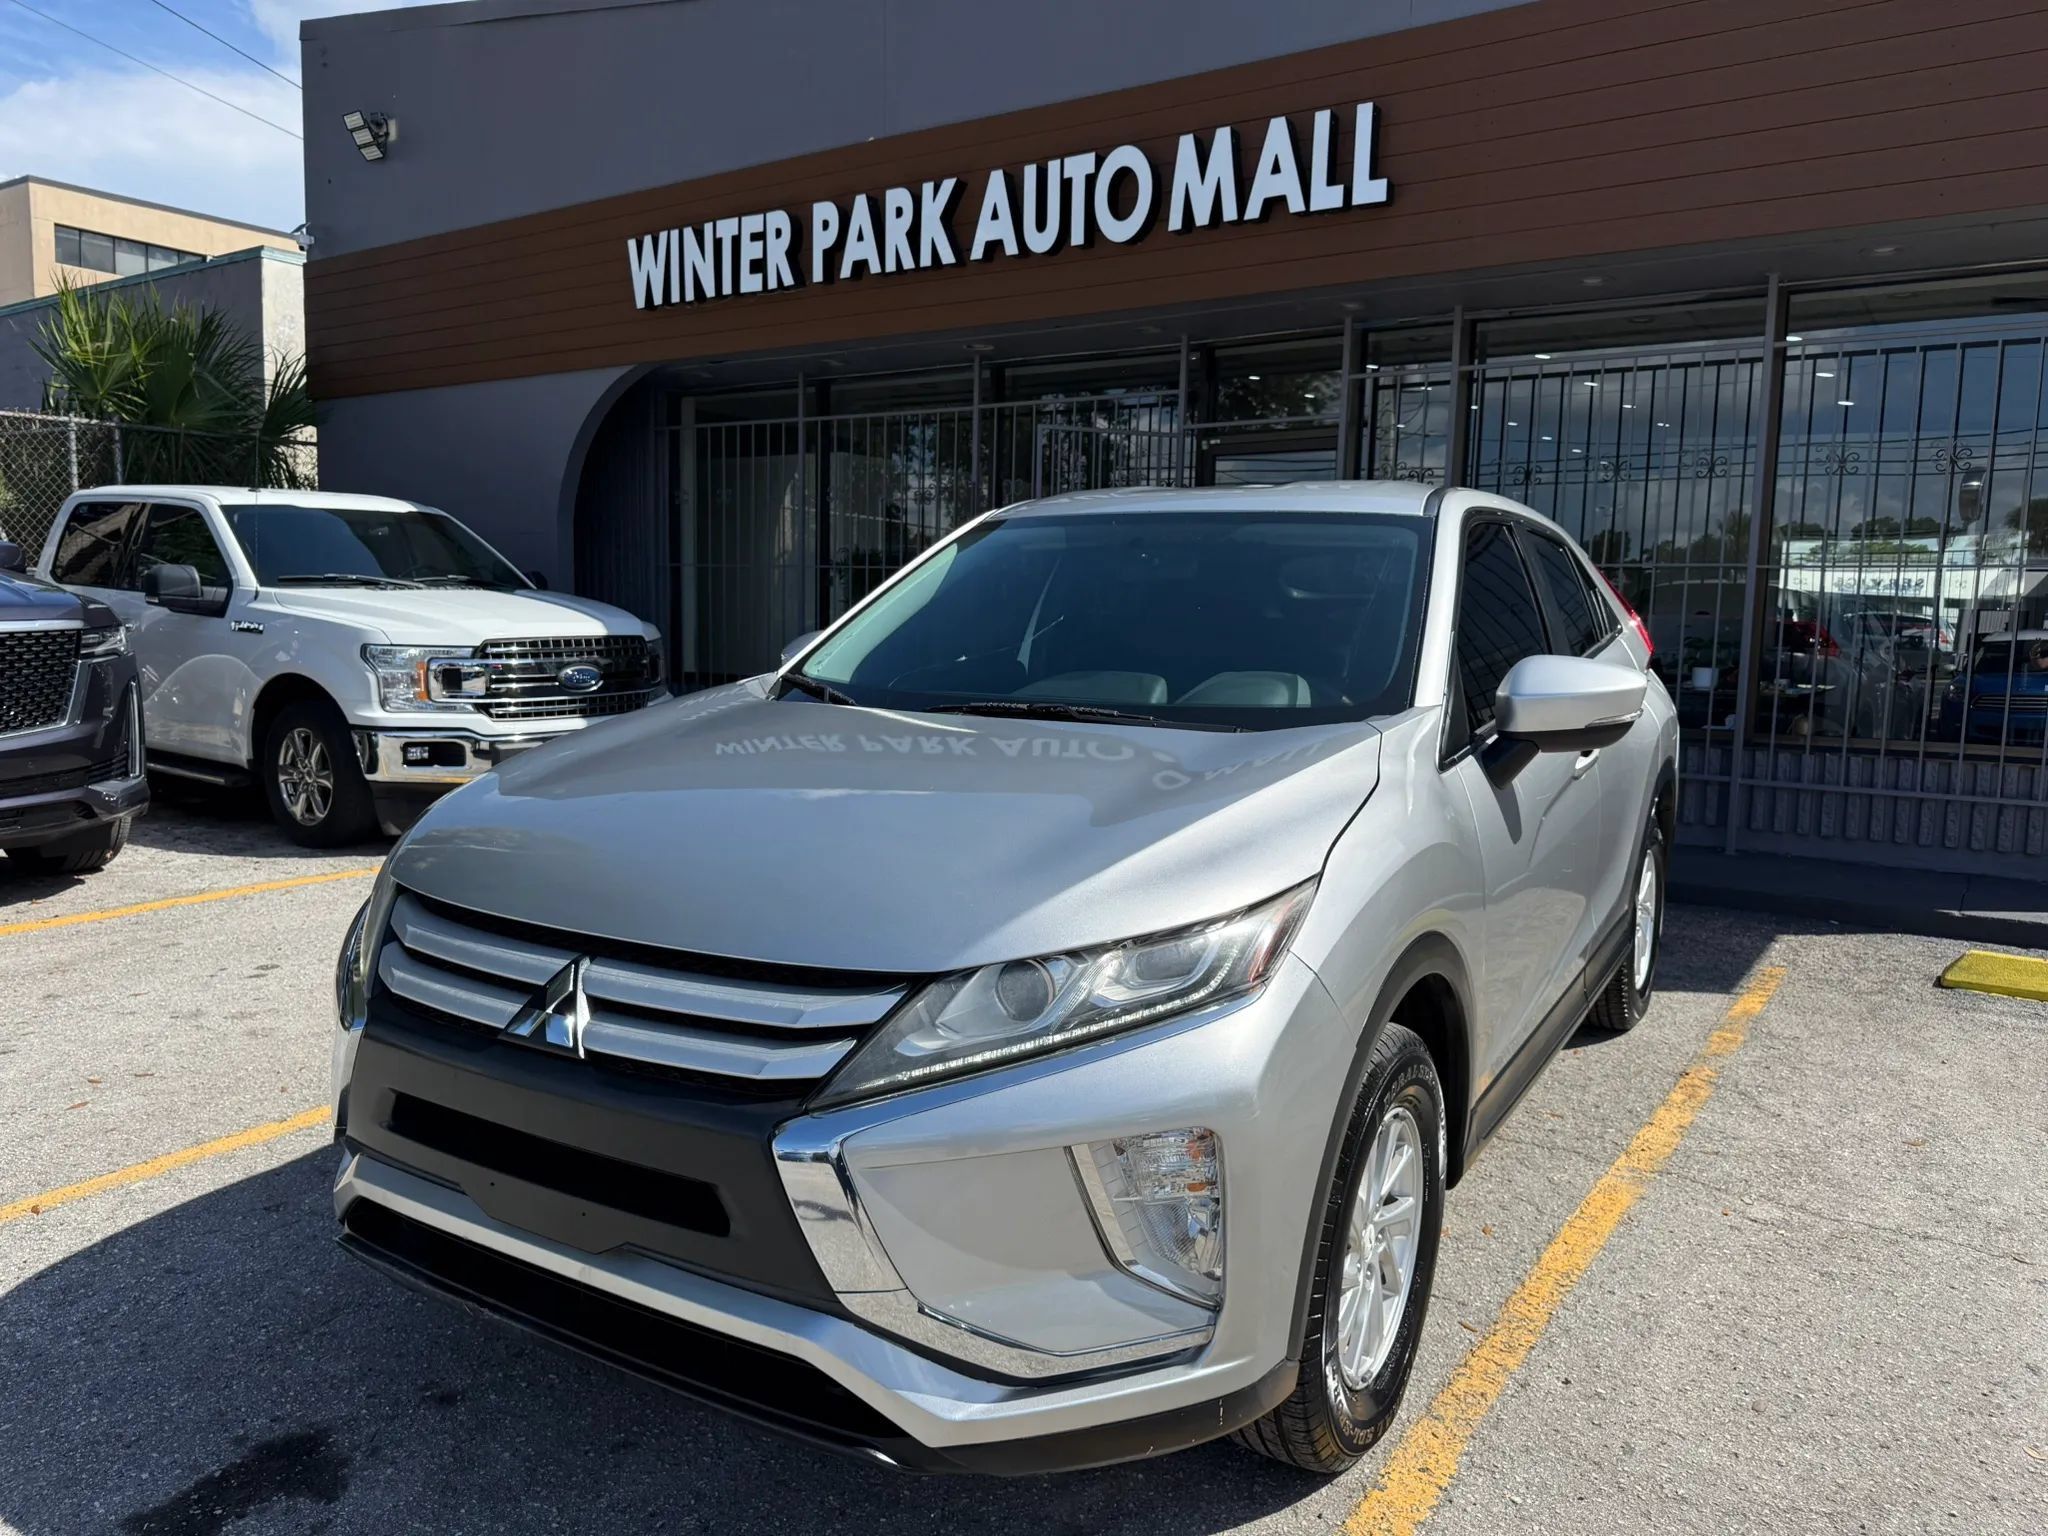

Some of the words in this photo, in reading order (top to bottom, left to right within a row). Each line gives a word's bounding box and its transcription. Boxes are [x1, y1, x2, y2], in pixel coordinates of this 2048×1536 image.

[627, 210, 794, 310] WINTER
[812, 177, 957, 284] PARK
[970, 144, 1153, 261] AUTO
[1168, 102, 1388, 233] MALL
